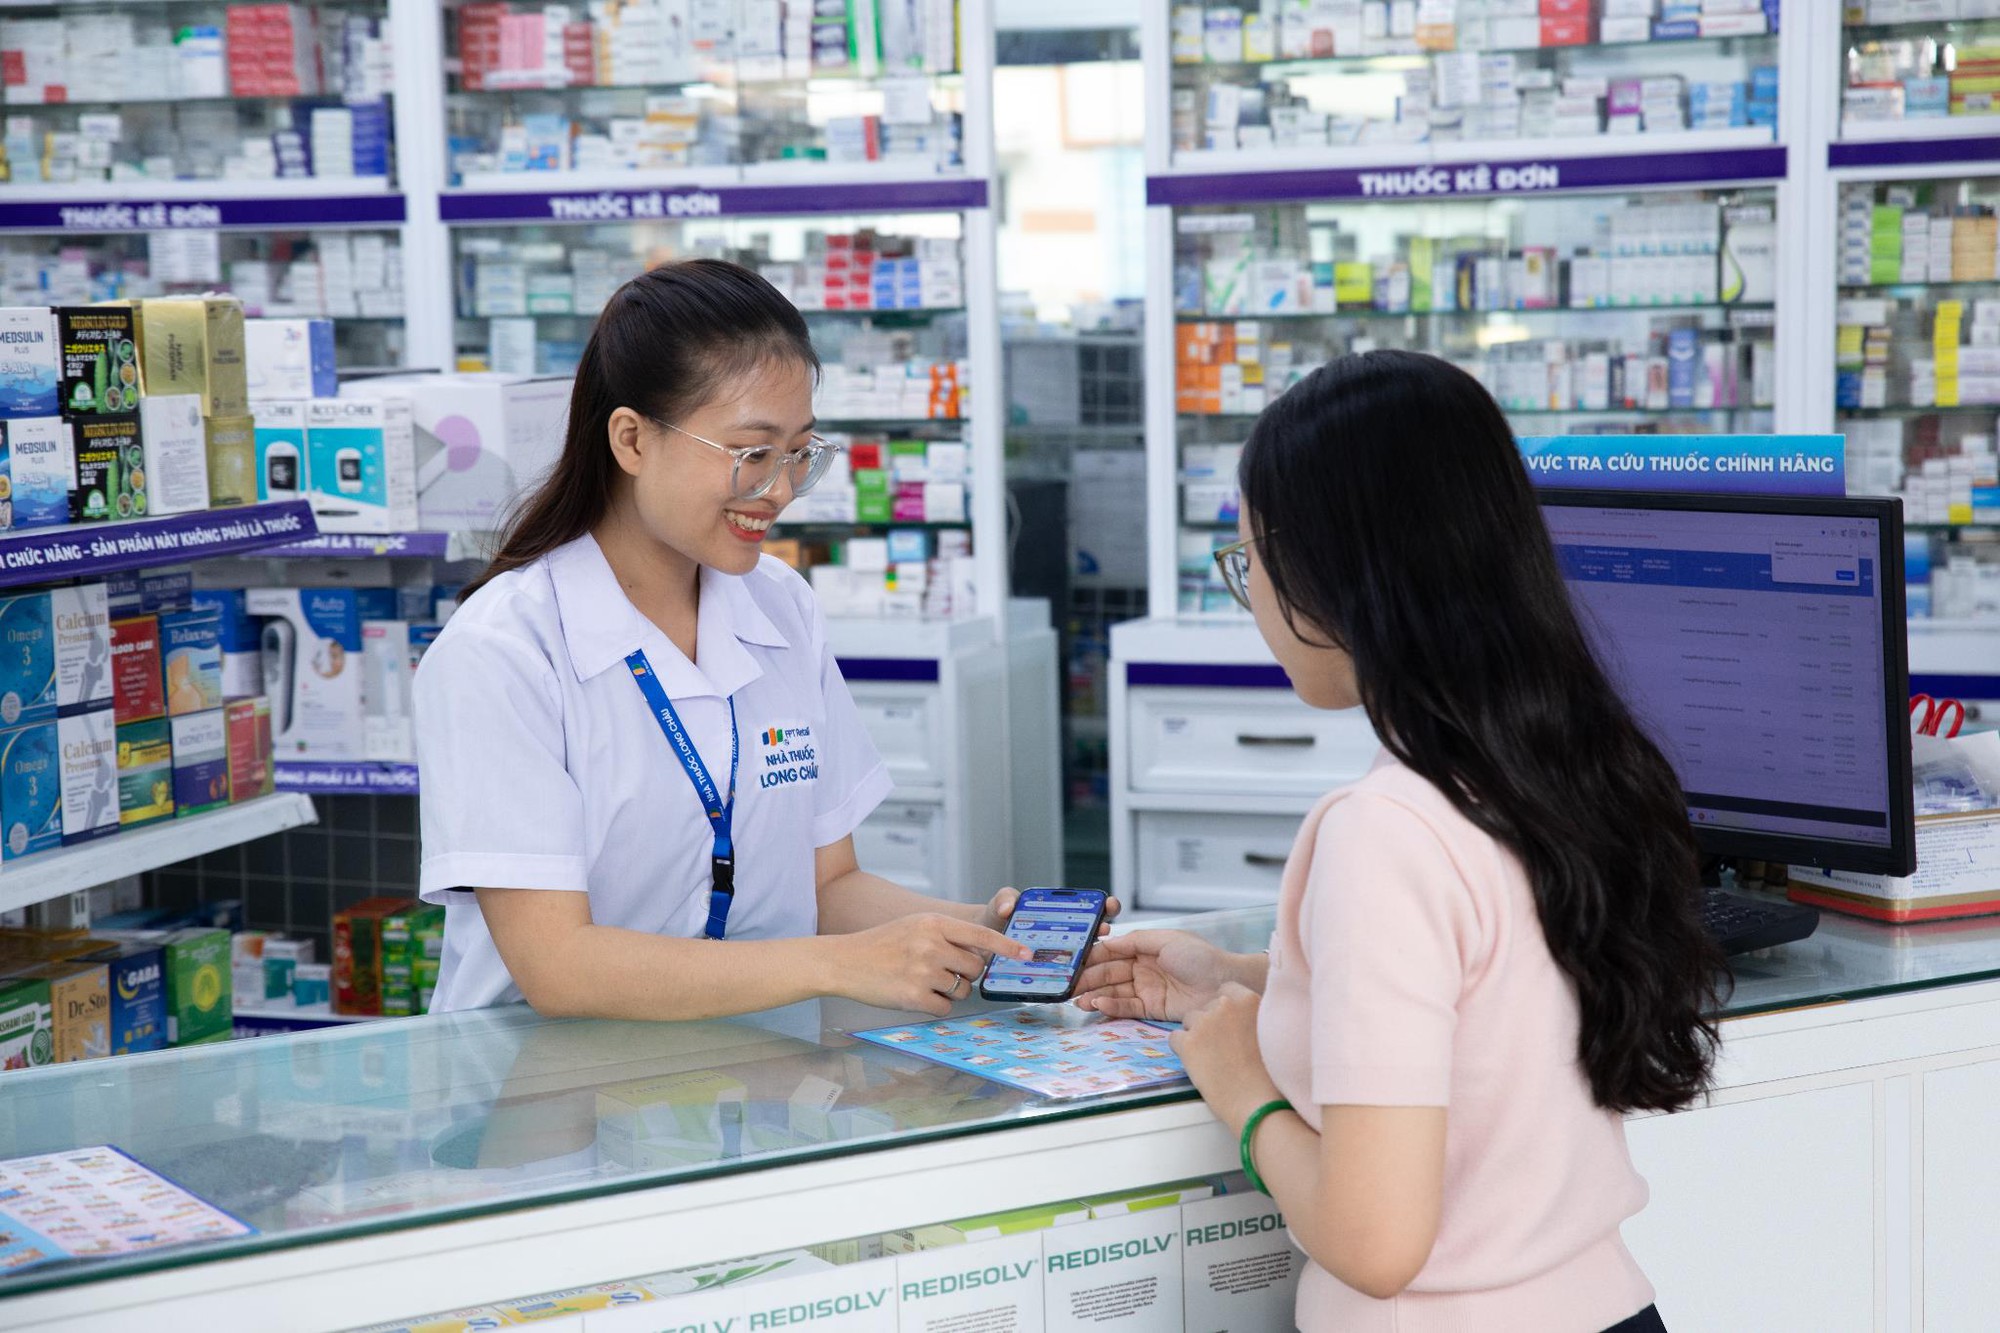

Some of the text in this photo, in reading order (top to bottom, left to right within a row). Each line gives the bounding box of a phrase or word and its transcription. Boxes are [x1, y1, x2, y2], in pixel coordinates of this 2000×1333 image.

[1358, 163, 1559, 195] THUỐC KÊ ĐƠN
[59, 201, 135, 228] THUỐC
[548, 191, 629, 219] THUỐC
[666, 191, 721, 215] ĐƠN
[15, 440, 57, 454] MEDSULIN
[1528, 451, 1835, 474] VỰC TRA CỨU THUỐC CHÍNH HÃNG
[6, 547, 44, 568] CHỨC
[44, 543, 82, 562] NĂNG
[118, 532, 155, 553] PHẨM
[155, 530, 179, 550] NÀY
[180, 527, 221, 546] KHÔNG
[221, 520, 248, 540] PHẢI
[248, 519, 265, 536] LÀ
[264, 512, 302, 534] THUỐC
[56, 611, 106, 631] Calcium
[7, 628, 43, 643] Omega
[58, 631, 95, 648] Premium
[22, 646, 31, 666] 3
[784, 729, 797, 738] FPT
[63, 737, 113, 760] Calcium
[661, 708, 715, 803] NHÀ THUỐC LONG CHÂU
[765, 744, 815, 767] NHÀ THUỐC
[14, 758, 48, 774] Omega
[64, 758, 102, 775] Premium
[29, 776, 38, 795] 3
[760, 768, 799, 789] LONG
[127, 964, 160, 987] GABA
[1186, 1212, 1287, 1247] REDISOL
